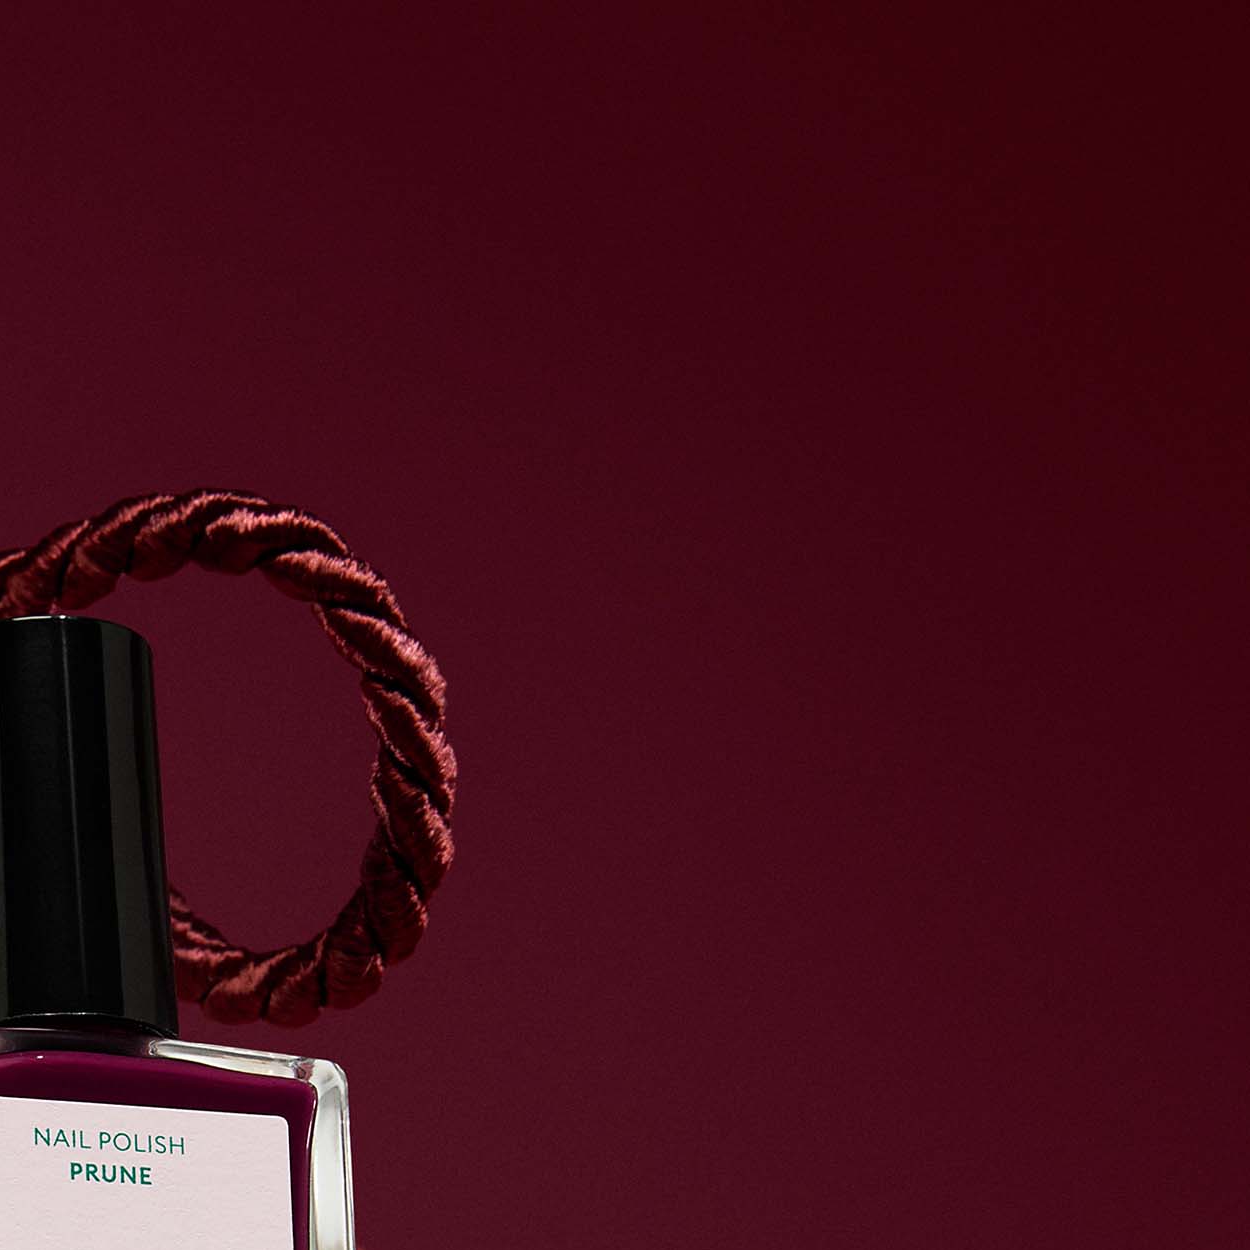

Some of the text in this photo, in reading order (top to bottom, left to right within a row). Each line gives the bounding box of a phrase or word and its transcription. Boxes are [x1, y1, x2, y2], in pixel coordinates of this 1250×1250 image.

[33, 1127, 186, 1156] NAIL POLISH
[69, 1161, 153, 1186] PRUNE
